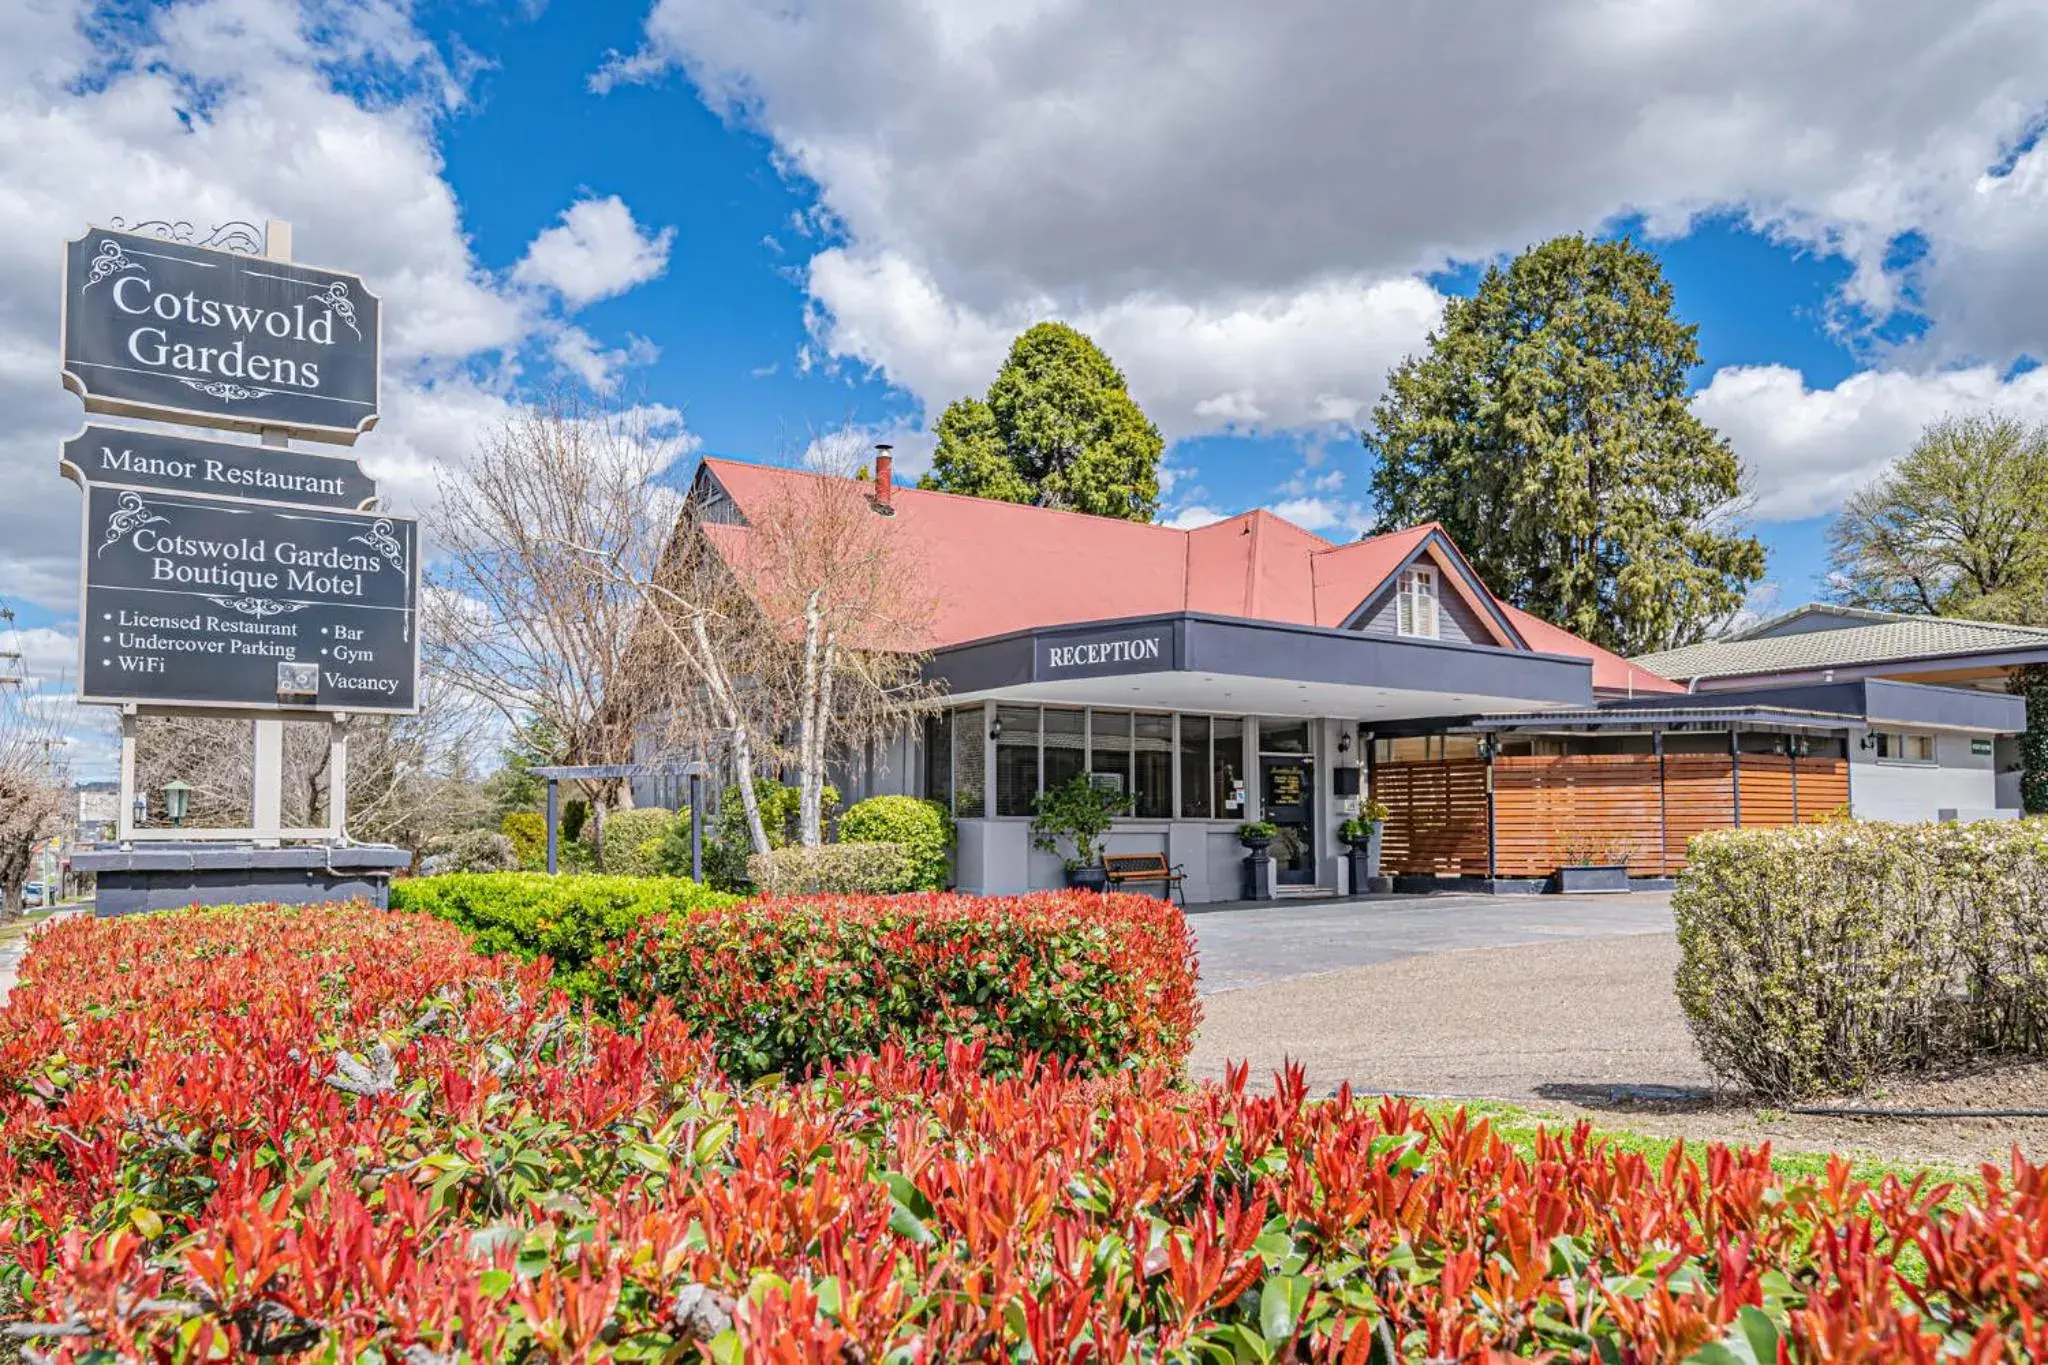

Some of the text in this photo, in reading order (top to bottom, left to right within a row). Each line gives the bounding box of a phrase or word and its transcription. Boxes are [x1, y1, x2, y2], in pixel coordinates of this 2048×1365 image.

[112, 276, 336, 345] Cotswold
[127, 327, 320, 389] Gardens
[100, 447, 345, 496] Manor Restaurant
[132, 529, 381, 573] Cotswold Gardens
[151, 557, 364, 597] Boutique Motel
[119, 610, 298, 637] Licensed Restaurant
[334, 625, 364, 640] Bar
[119, 633, 297, 661] Undercover Parking
[333, 646, 374, 663] Gym
[1049, 637, 1160, 668] RECEPTION
[118, 655, 166, 673] WiFi
[323, 671, 400, 694] Vacancy
